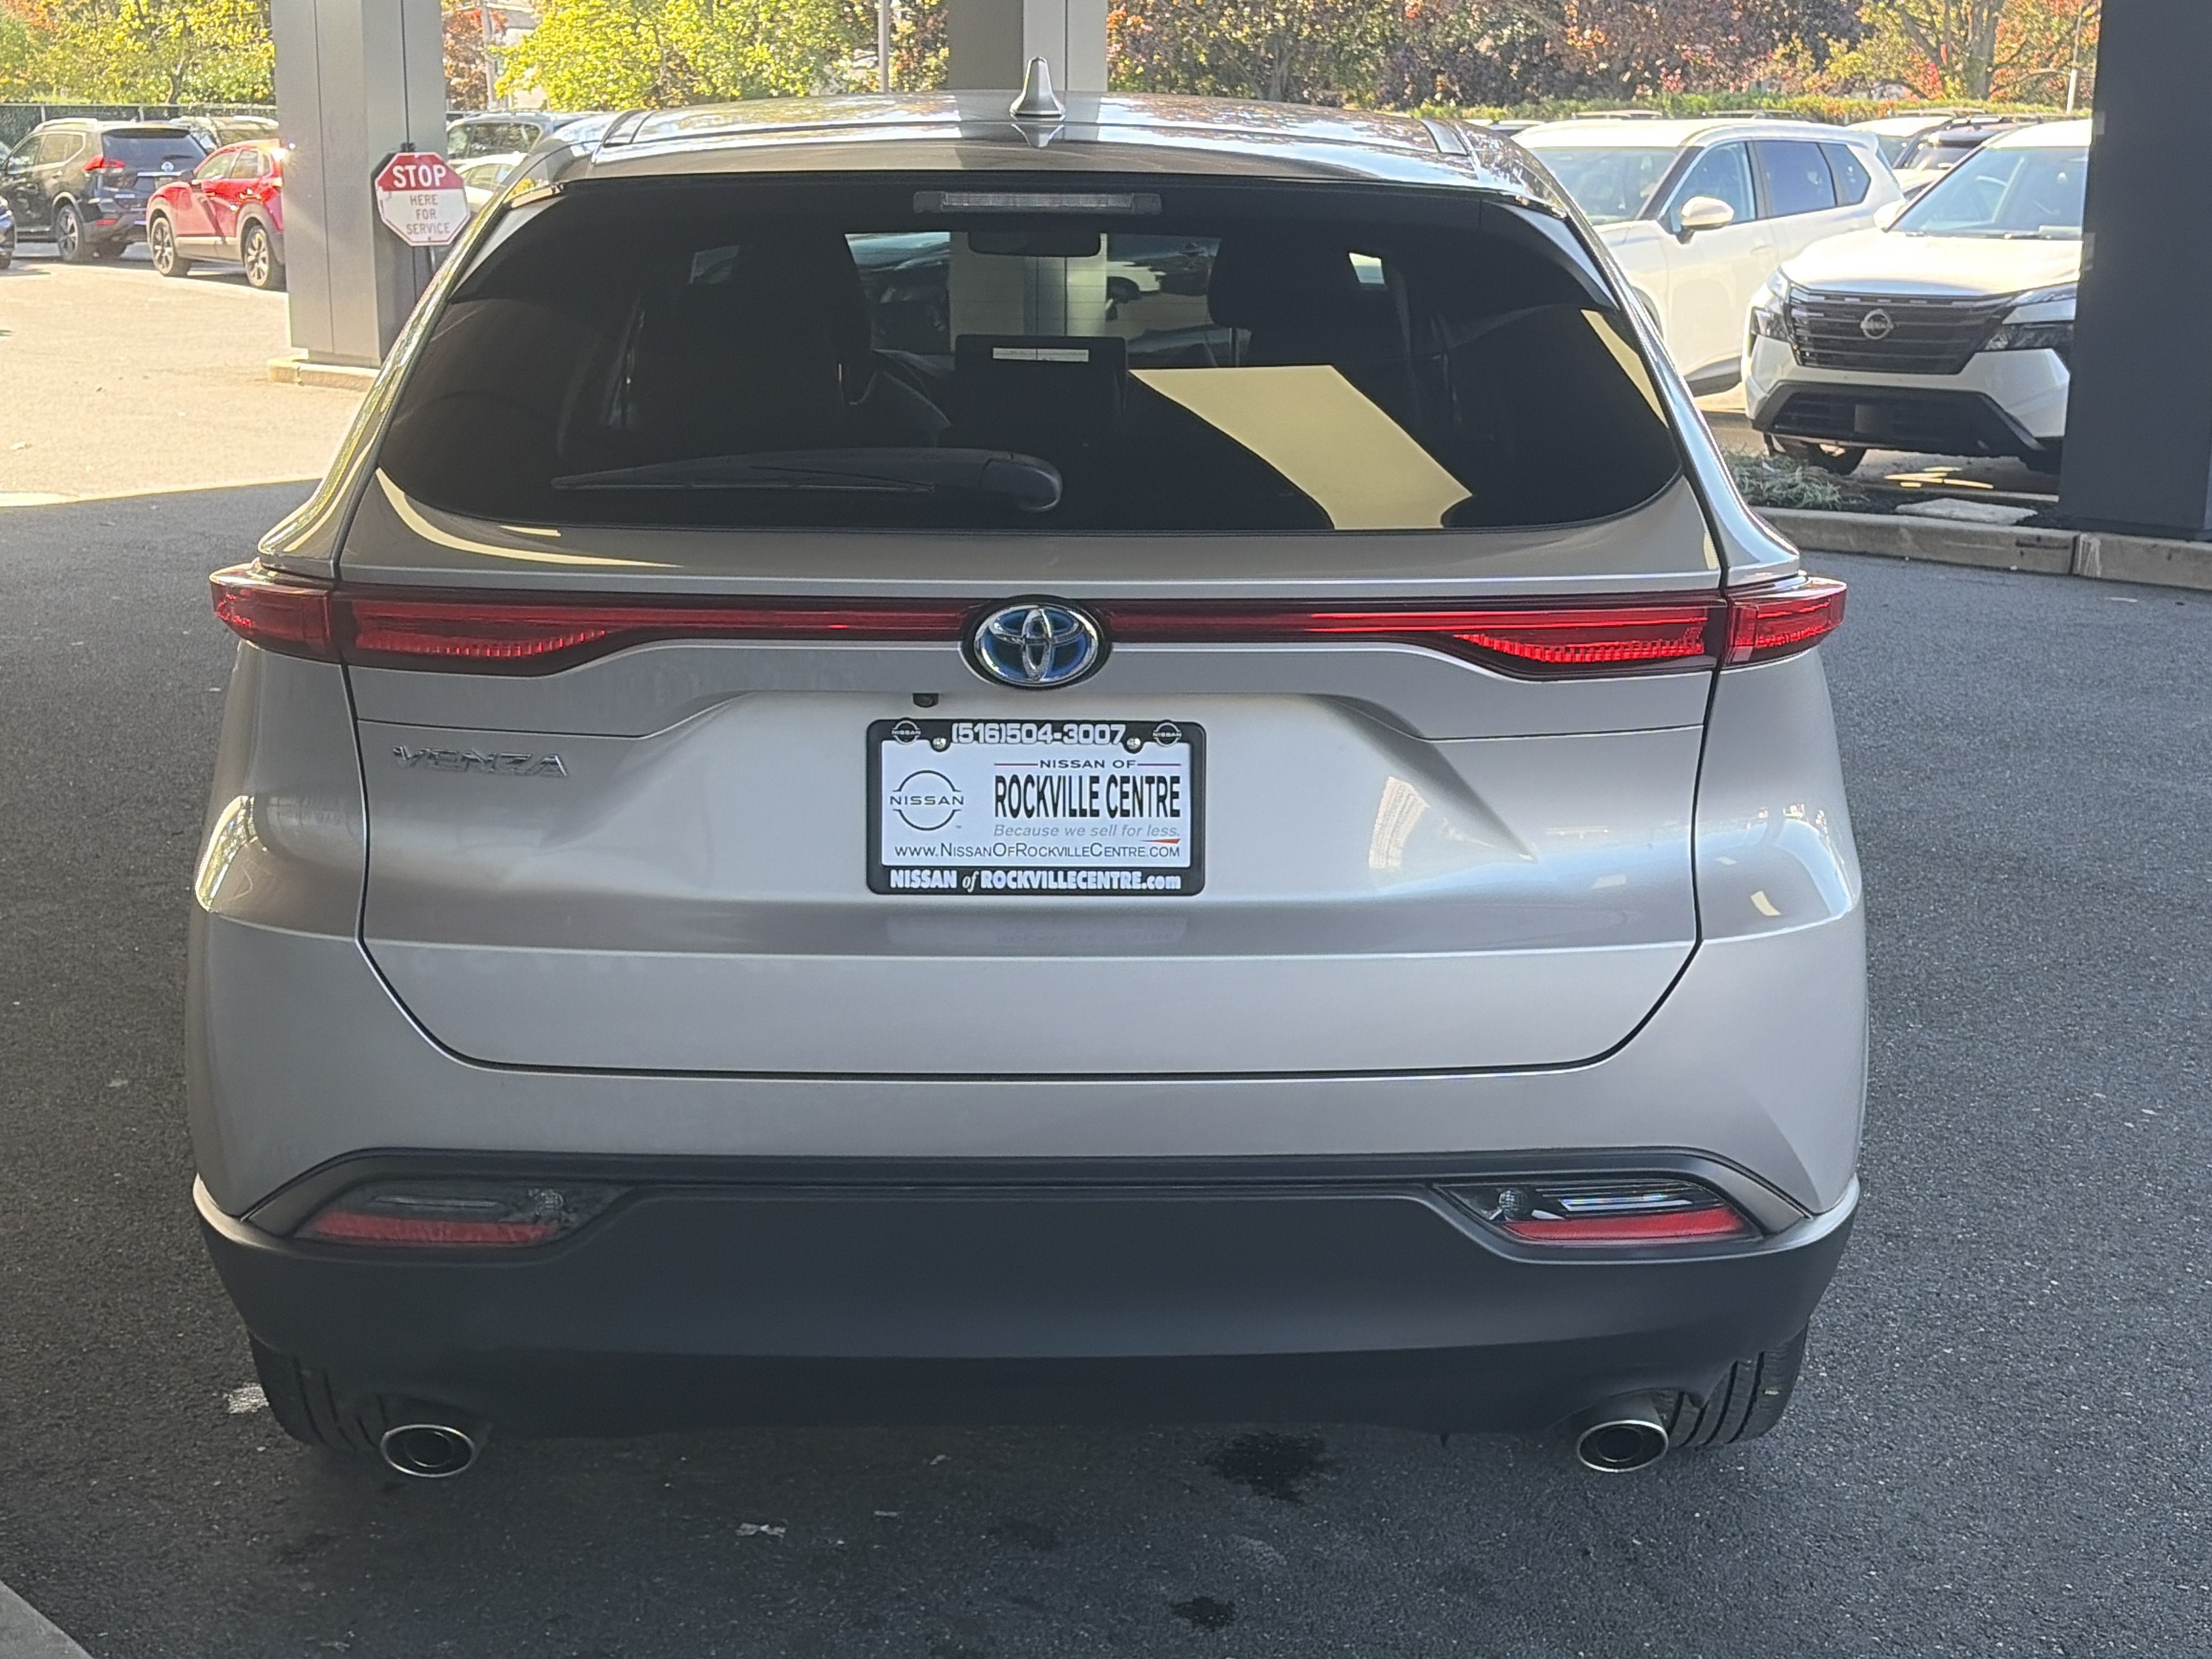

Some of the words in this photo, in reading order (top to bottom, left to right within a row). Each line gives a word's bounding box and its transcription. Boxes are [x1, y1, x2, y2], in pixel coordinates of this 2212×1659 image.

[392, 165, 447, 188] STOP
[410, 194, 438, 206] HERE
[415, 208, 437, 220] FOR
[406, 222, 450, 235] SERVICE
[952, 722, 1126, 744] (516)504-3007
[392, 746, 568, 777] VENZA
[1040, 760, 1105, 769] NISSAN
[1113, 760, 1137, 769] OF
[890, 795, 964, 805] NISSAN
[995, 774, 1100, 819] ROCKVILLE
[1106, 774, 1181, 819] CENTRE
[994, 824, 1059, 837] Because
[1064, 827, 1086, 837] we
[1090, 824, 1117, 837] sell
[1121, 824, 1143, 837] for
[1147, 824, 1180, 837] less.
[890, 869, 957, 889] NISSAN
[962, 871, 980, 893] of
[980, 870, 1182, 890] ROCKVILLECENTRE.com
